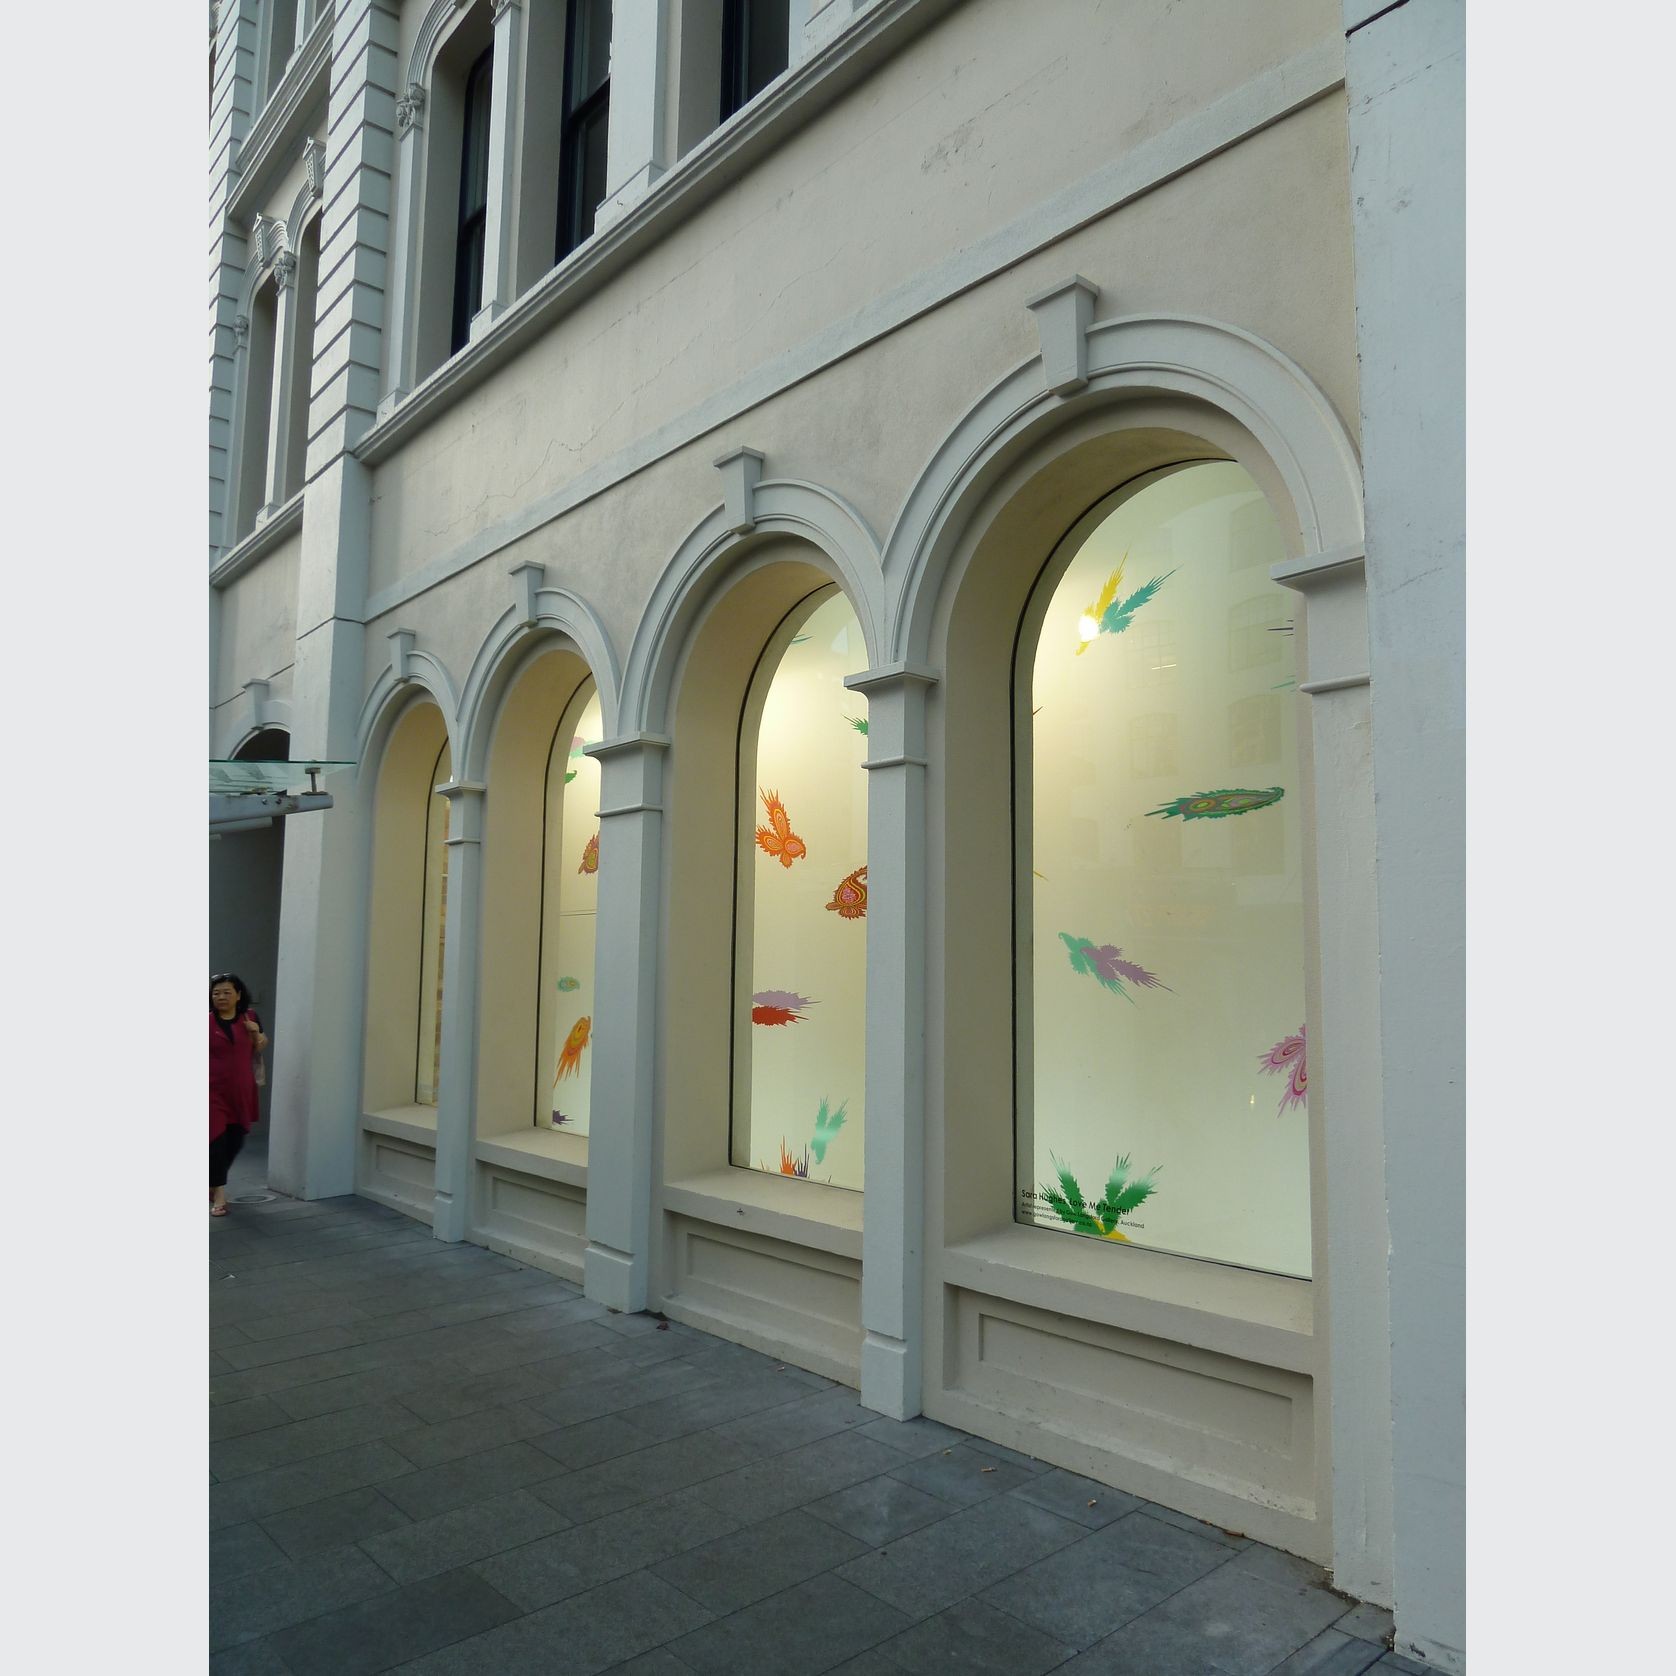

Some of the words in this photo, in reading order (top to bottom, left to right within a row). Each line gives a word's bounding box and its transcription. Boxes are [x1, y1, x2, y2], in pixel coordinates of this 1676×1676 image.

[1021, 1189, 1038, 1200] Sara
[1088, 1201, 1101, 1211] Me
[1120, 1219, 1145, 1229] Auckland
